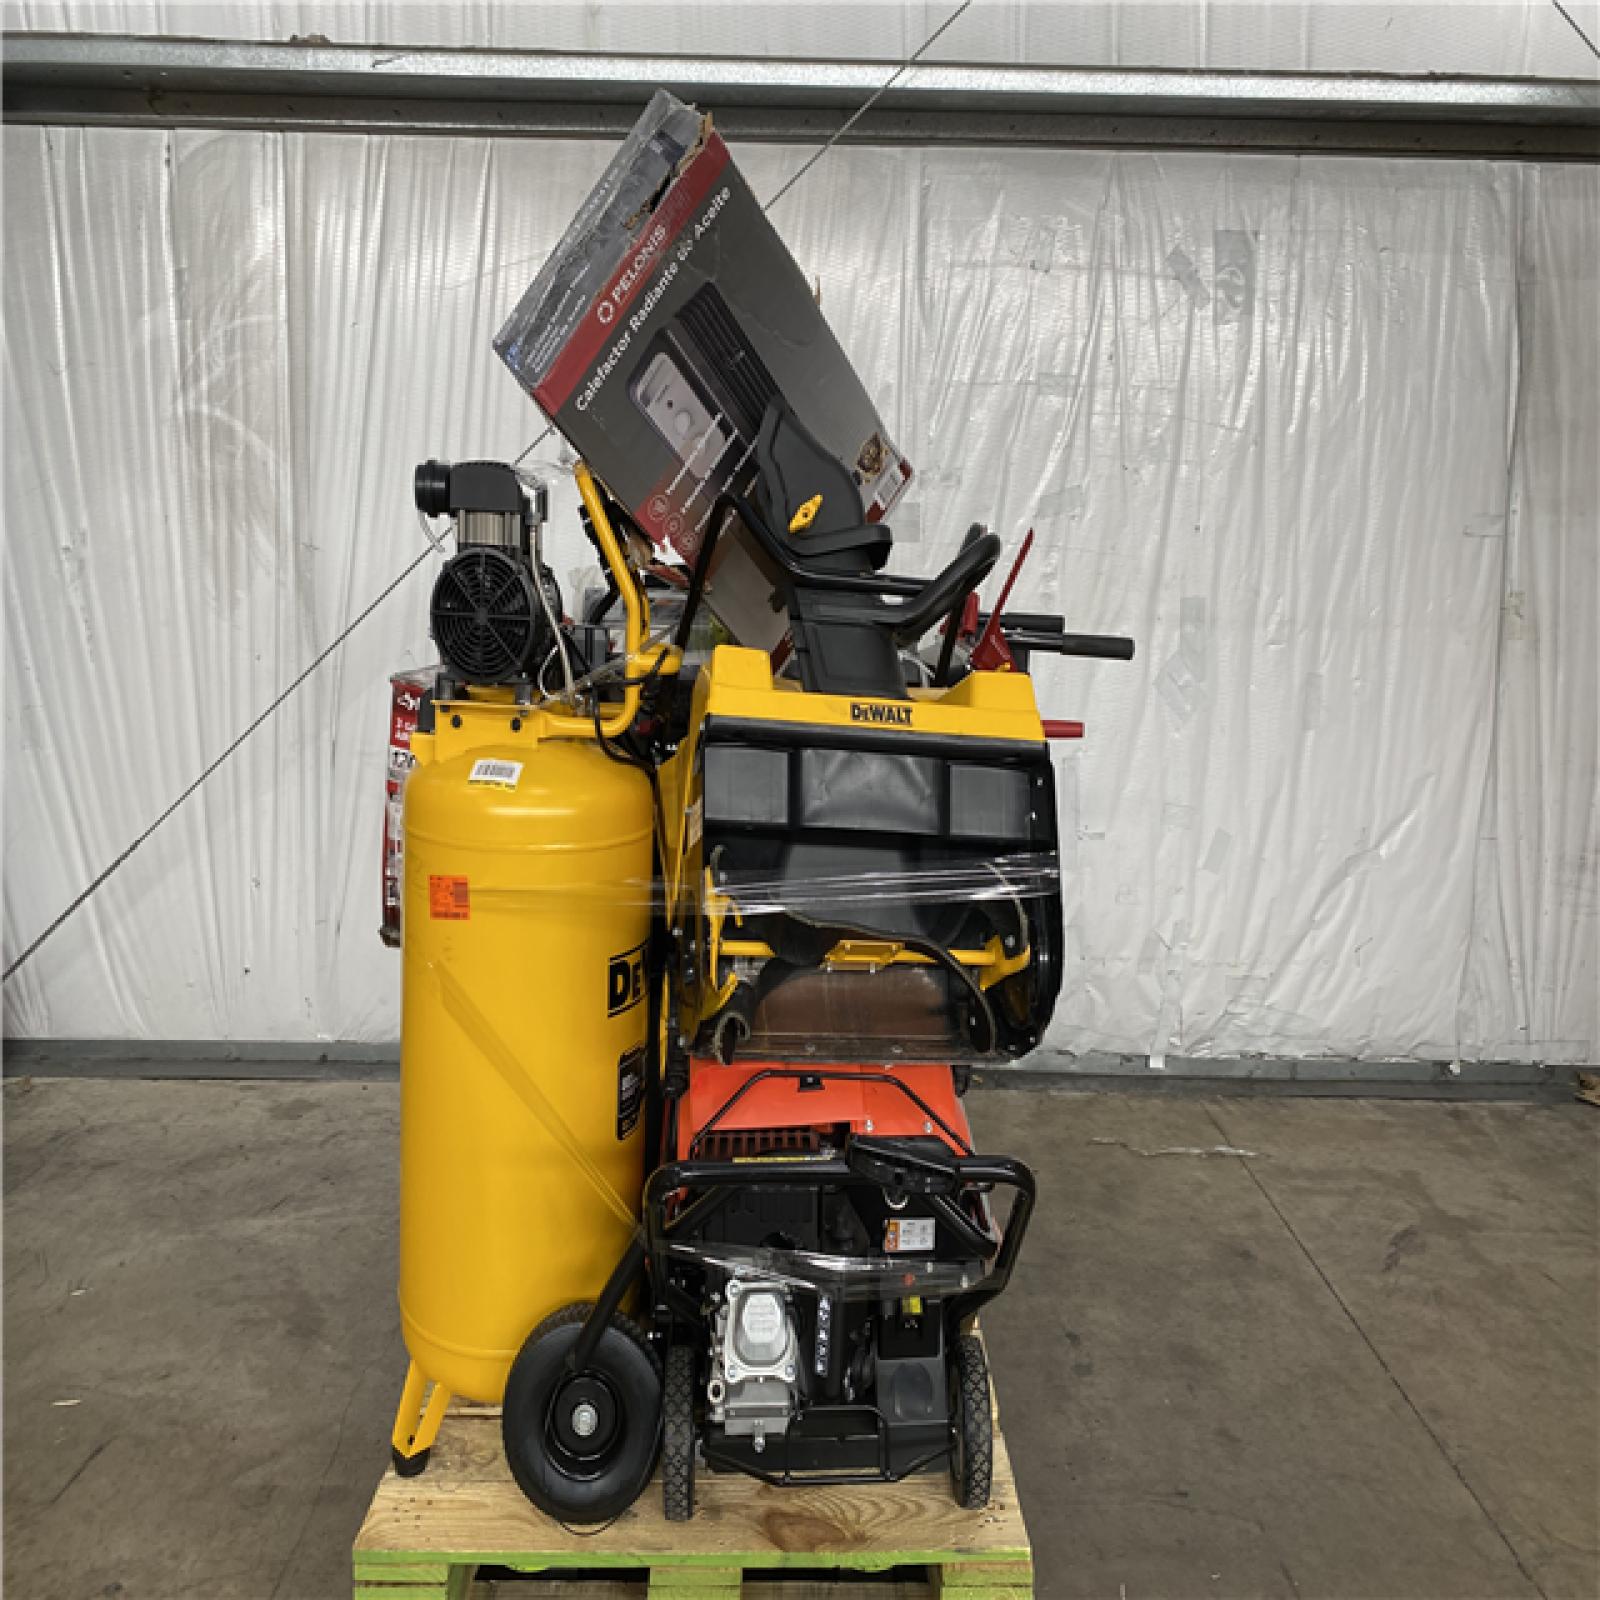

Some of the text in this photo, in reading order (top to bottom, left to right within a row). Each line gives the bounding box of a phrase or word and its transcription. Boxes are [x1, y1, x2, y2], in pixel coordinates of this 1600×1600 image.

[575, 330, 631, 411] Calefactor
[630, 262, 679, 333] Radiante
[695, 187, 731, 240] Aceite
[612, 224, 666, 303] PELONIS
